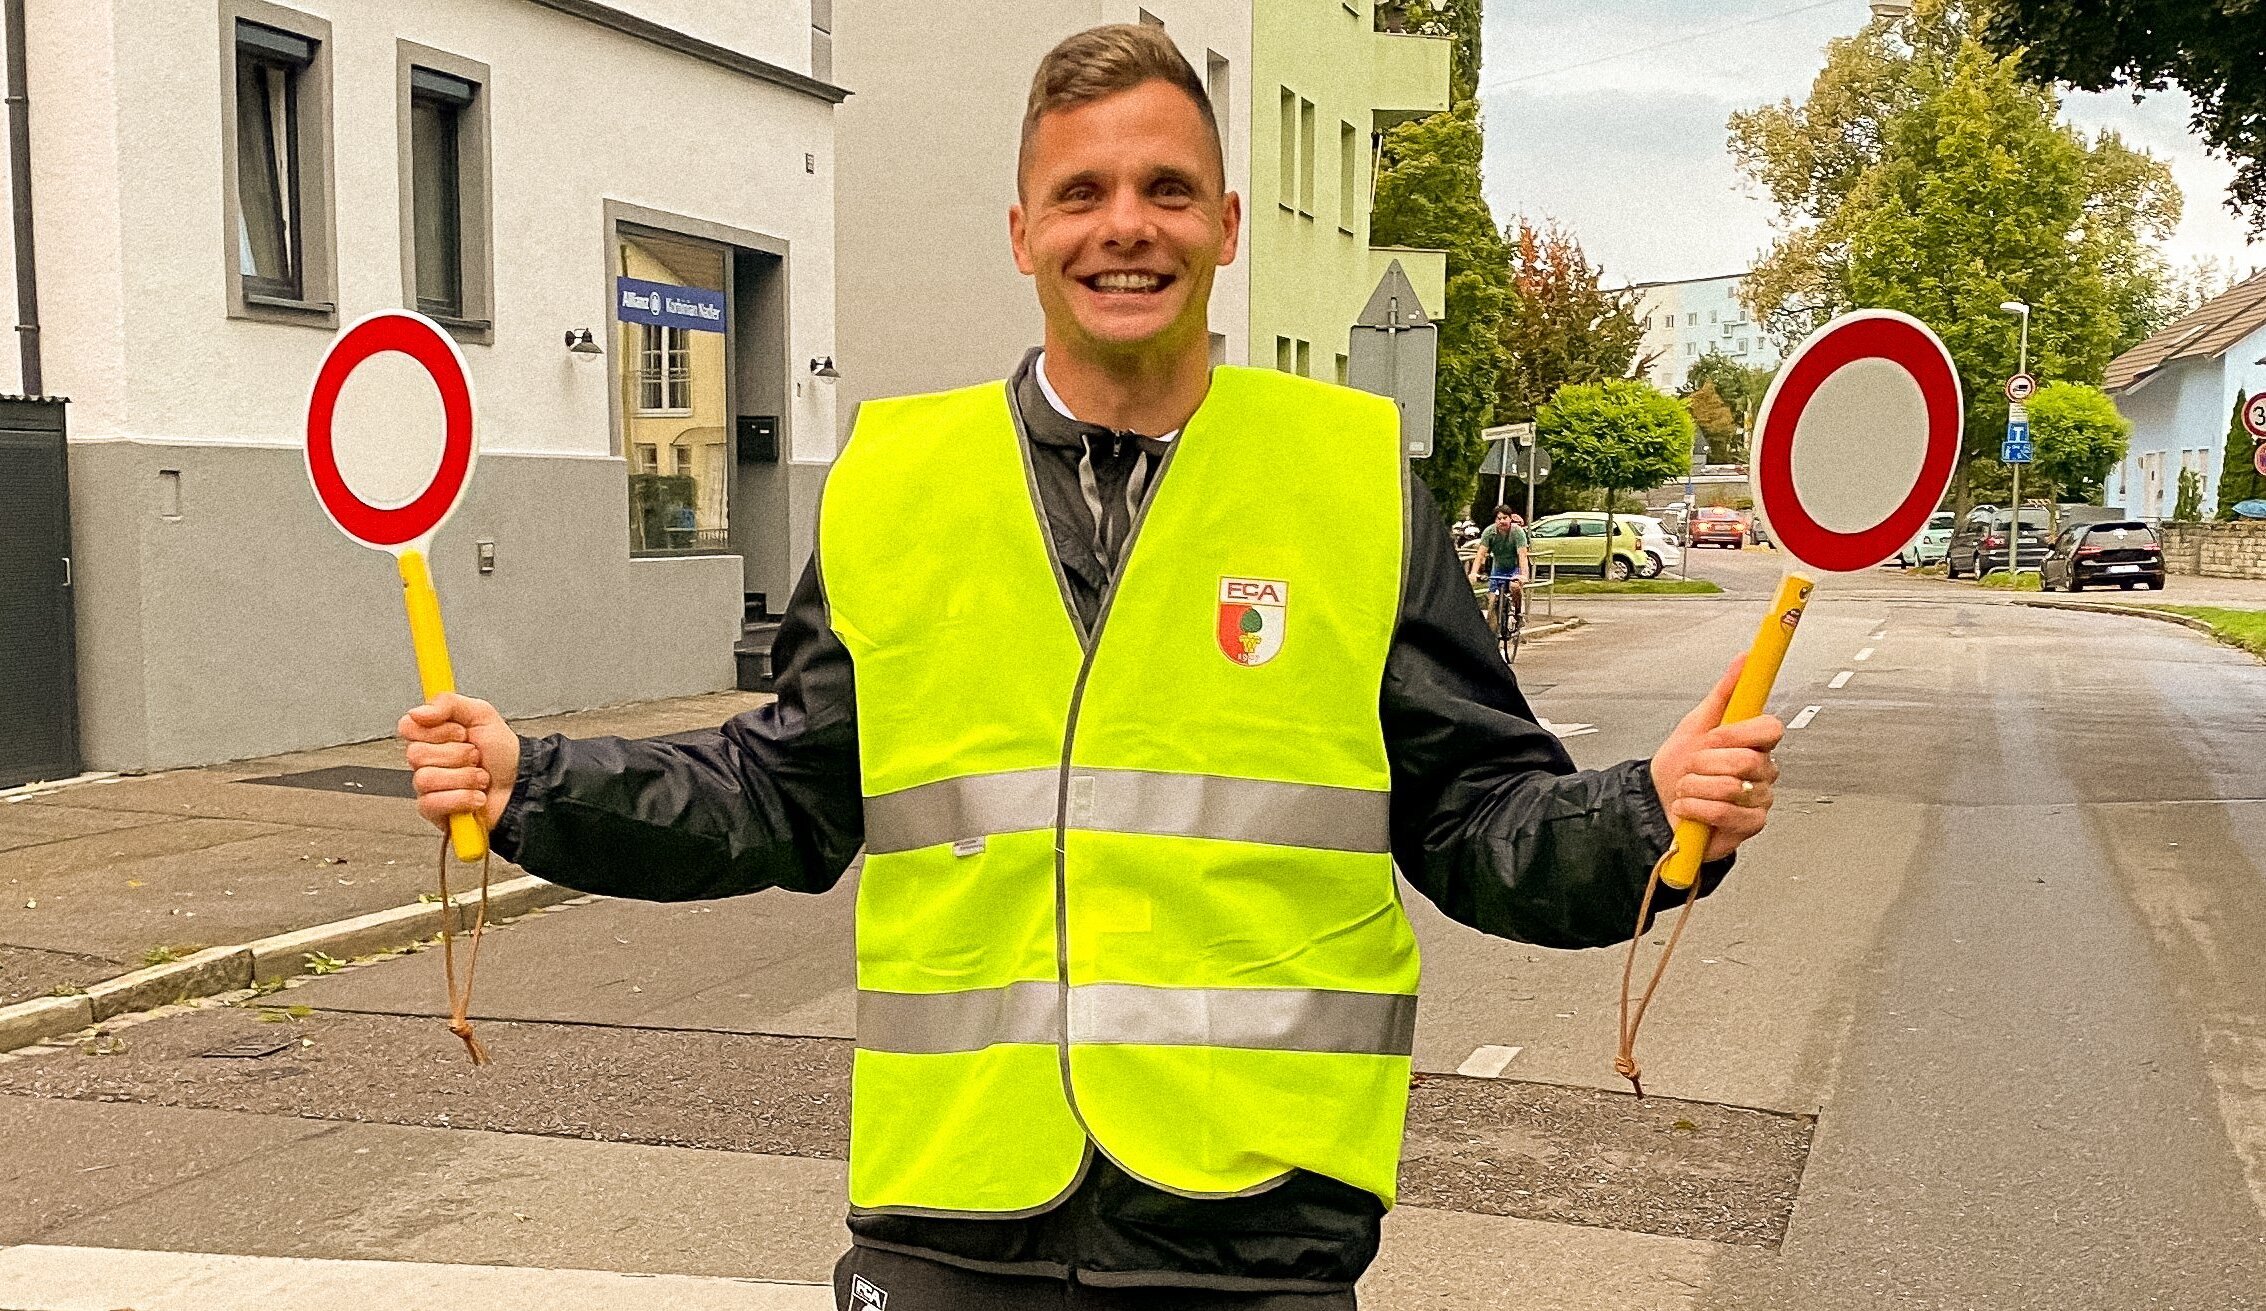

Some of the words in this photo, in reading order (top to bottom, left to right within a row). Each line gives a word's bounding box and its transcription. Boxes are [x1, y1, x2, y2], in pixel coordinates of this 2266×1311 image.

[622, 290, 650, 310] Allianz
[1227, 582, 1280, 603] FCA
[855, 1279, 882, 1310] FCA
